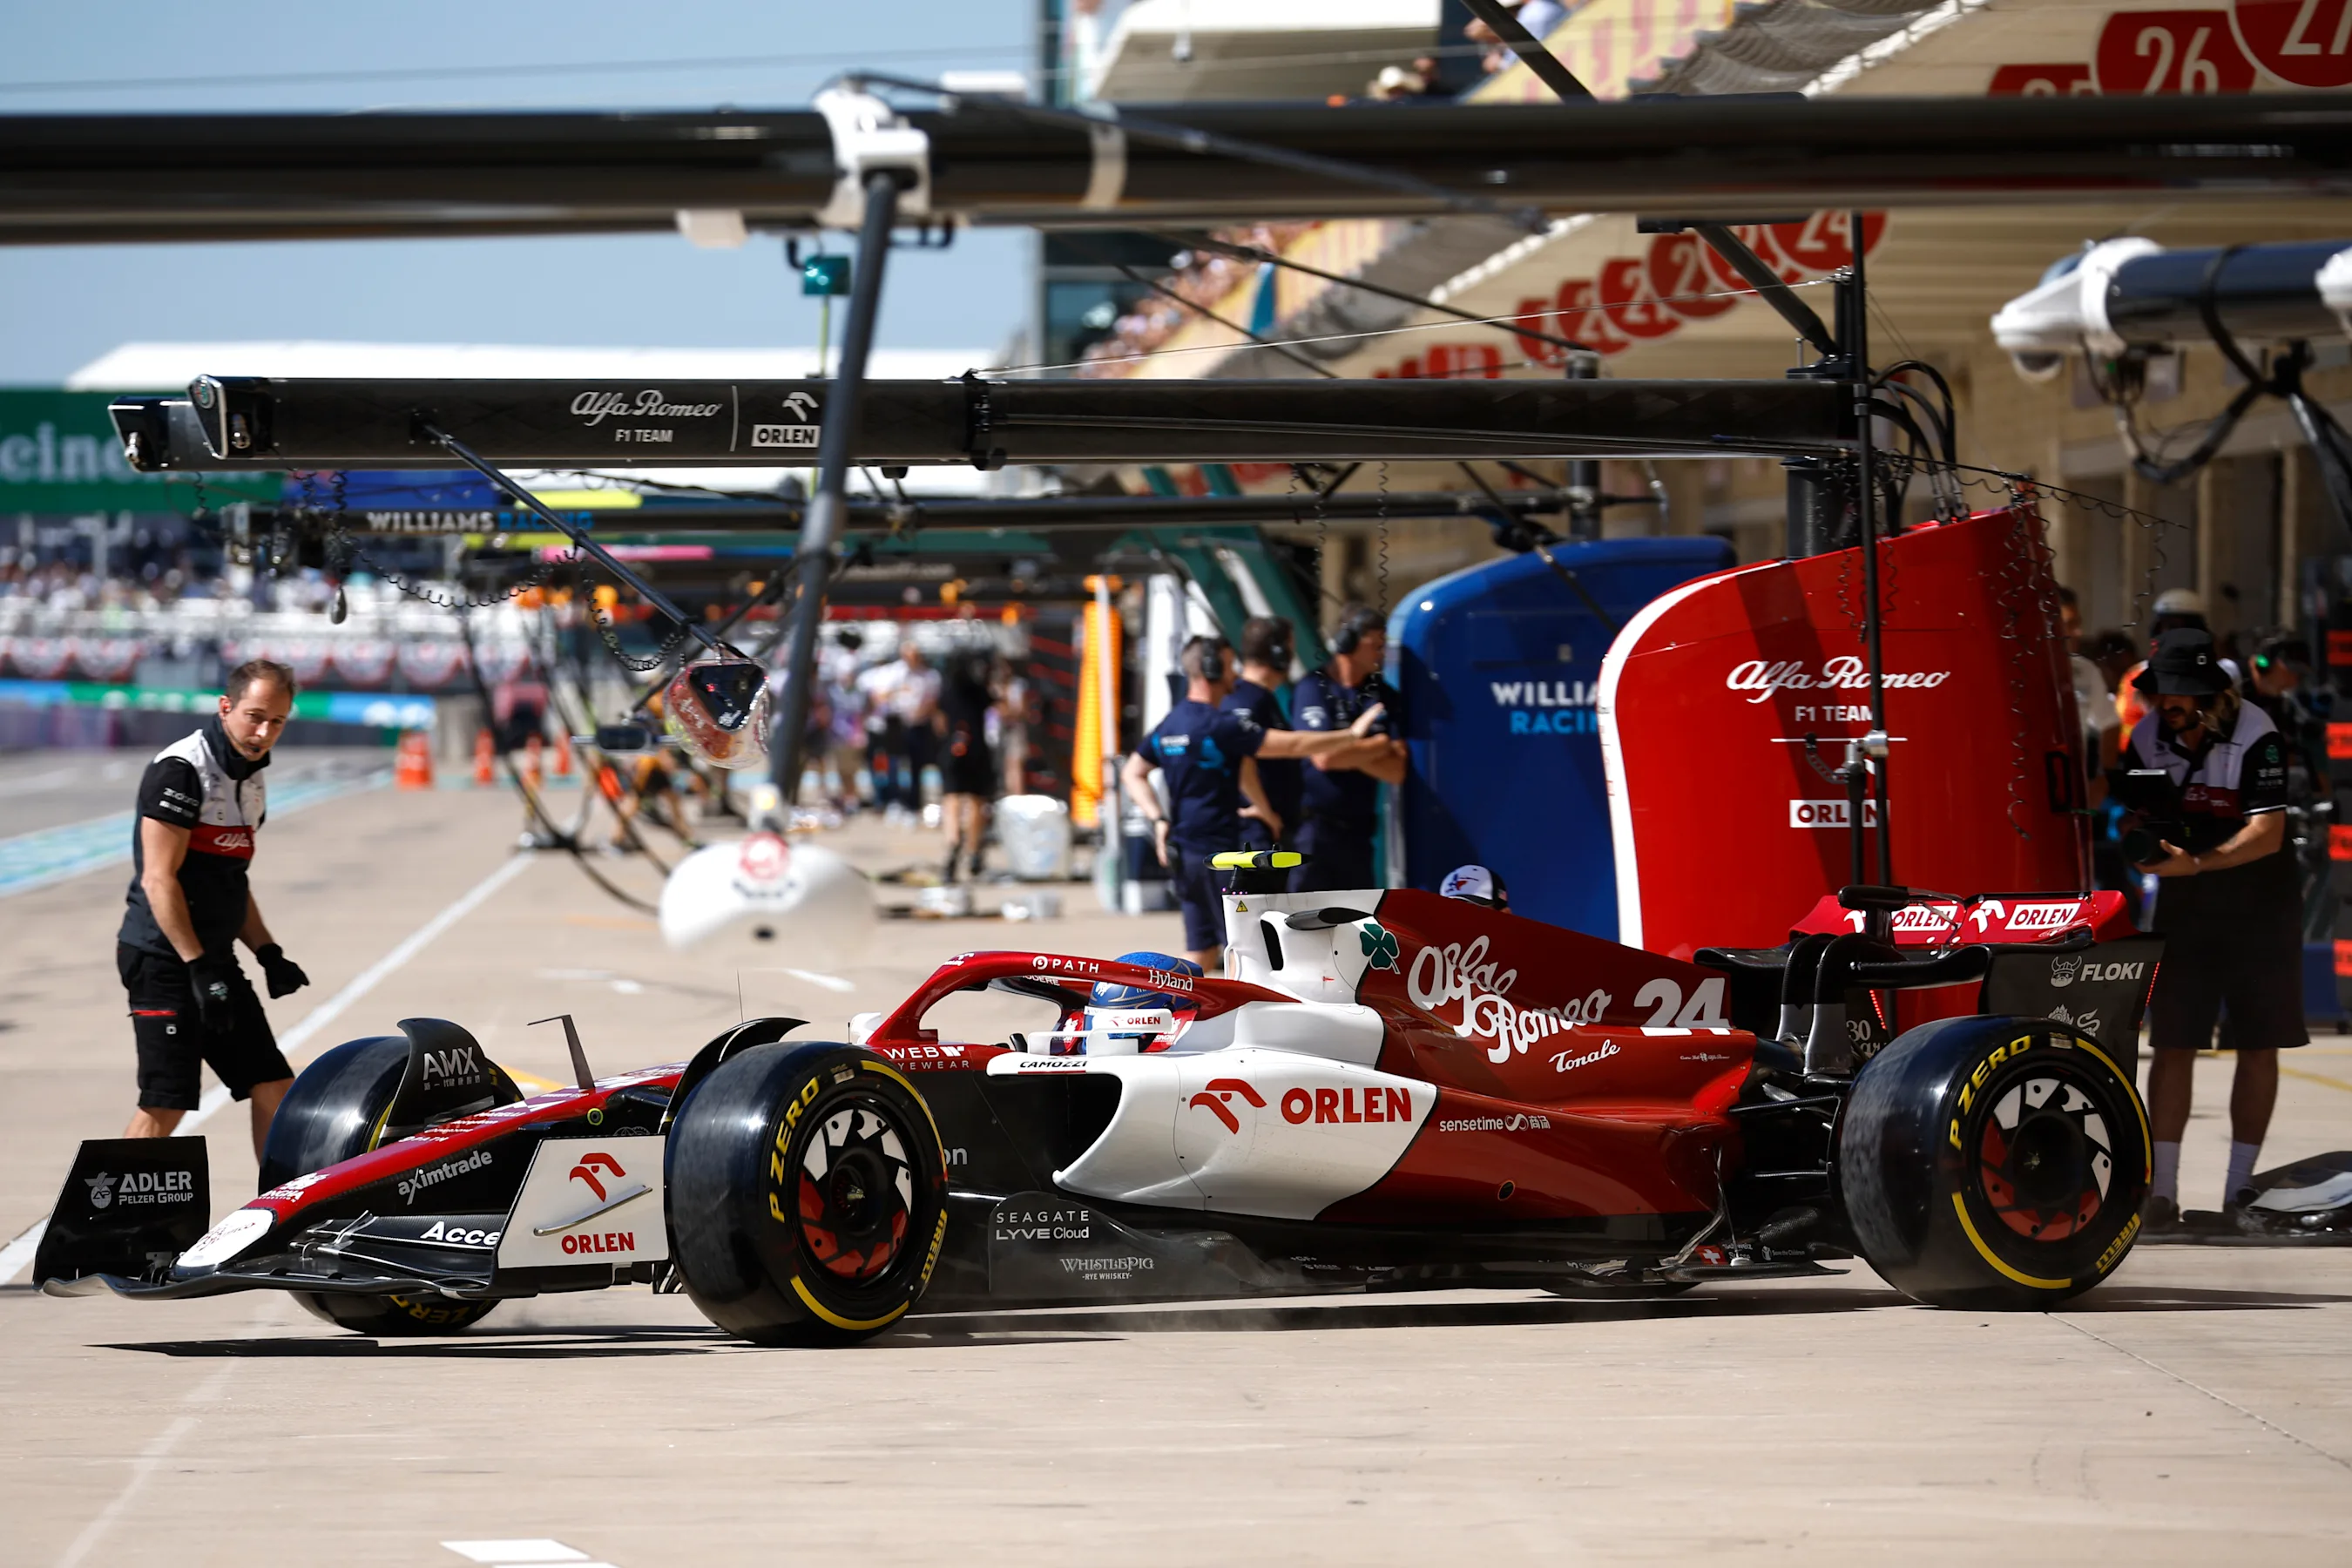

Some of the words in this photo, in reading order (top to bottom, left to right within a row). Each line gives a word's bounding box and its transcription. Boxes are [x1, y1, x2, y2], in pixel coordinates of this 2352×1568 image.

[2135, 26, 2219, 97] 26
[571, 391, 631, 427] Alfa
[632, 389, 722, 417] Romeo
[615, 429, 632, 443] F1
[635, 429, 673, 443] TEAM
[757, 429, 816, 444] ORLEN
[366, 510, 495, 531] WILLIAMS
[1726, 660, 1816, 704] Alfa
[1794, 706, 1816, 722] F1
[1797, 804, 1877, 823] ORLN
[2013, 907, 2069, 926] ORLEN
[1051, 958, 1100, 974] PATH
[2080, 962, 2145, 982] FLOKI
[1148, 970, 1193, 992] Hyland
[1407, 935, 1517, 1038] Alfa
[1472, 988, 1612, 1064] Romeo
[1633, 977, 1734, 1037] 24
[1127, 1016, 1161, 1025] ORLEN
[1846, 1019, 1872, 1042] 30
[883, 1046, 940, 1059] WEB
[1548, 1039, 1621, 1074] Tonale
[422, 1046, 480, 1081] AMX
[898, 1060, 970, 1071] YEWEAR
[1019, 1060, 1088, 1069] CAMOZZI
[1949, 1119, 1963, 1151] P
[1957, 1034, 2031, 1116] ZERO
[1281, 1086, 1412, 1125] ORLEN
[769, 1076, 821, 1186] ZERO
[1439, 1116, 1504, 1132] sensetime
[118, 1171, 193, 1193] ADLER
[397, 1150, 493, 1206] aximtrade
[118, 1194, 155, 1206] PELZER
[158, 1192, 193, 1204] GROUP
[763, 1191, 785, 1224] P
[996, 1210, 1090, 1224] SEAGATE
[561, 1232, 636, 1255] ORLEN
[996, 1228, 1051, 1240] LYVE
[1053, 1226, 1090, 1240] Cloud
